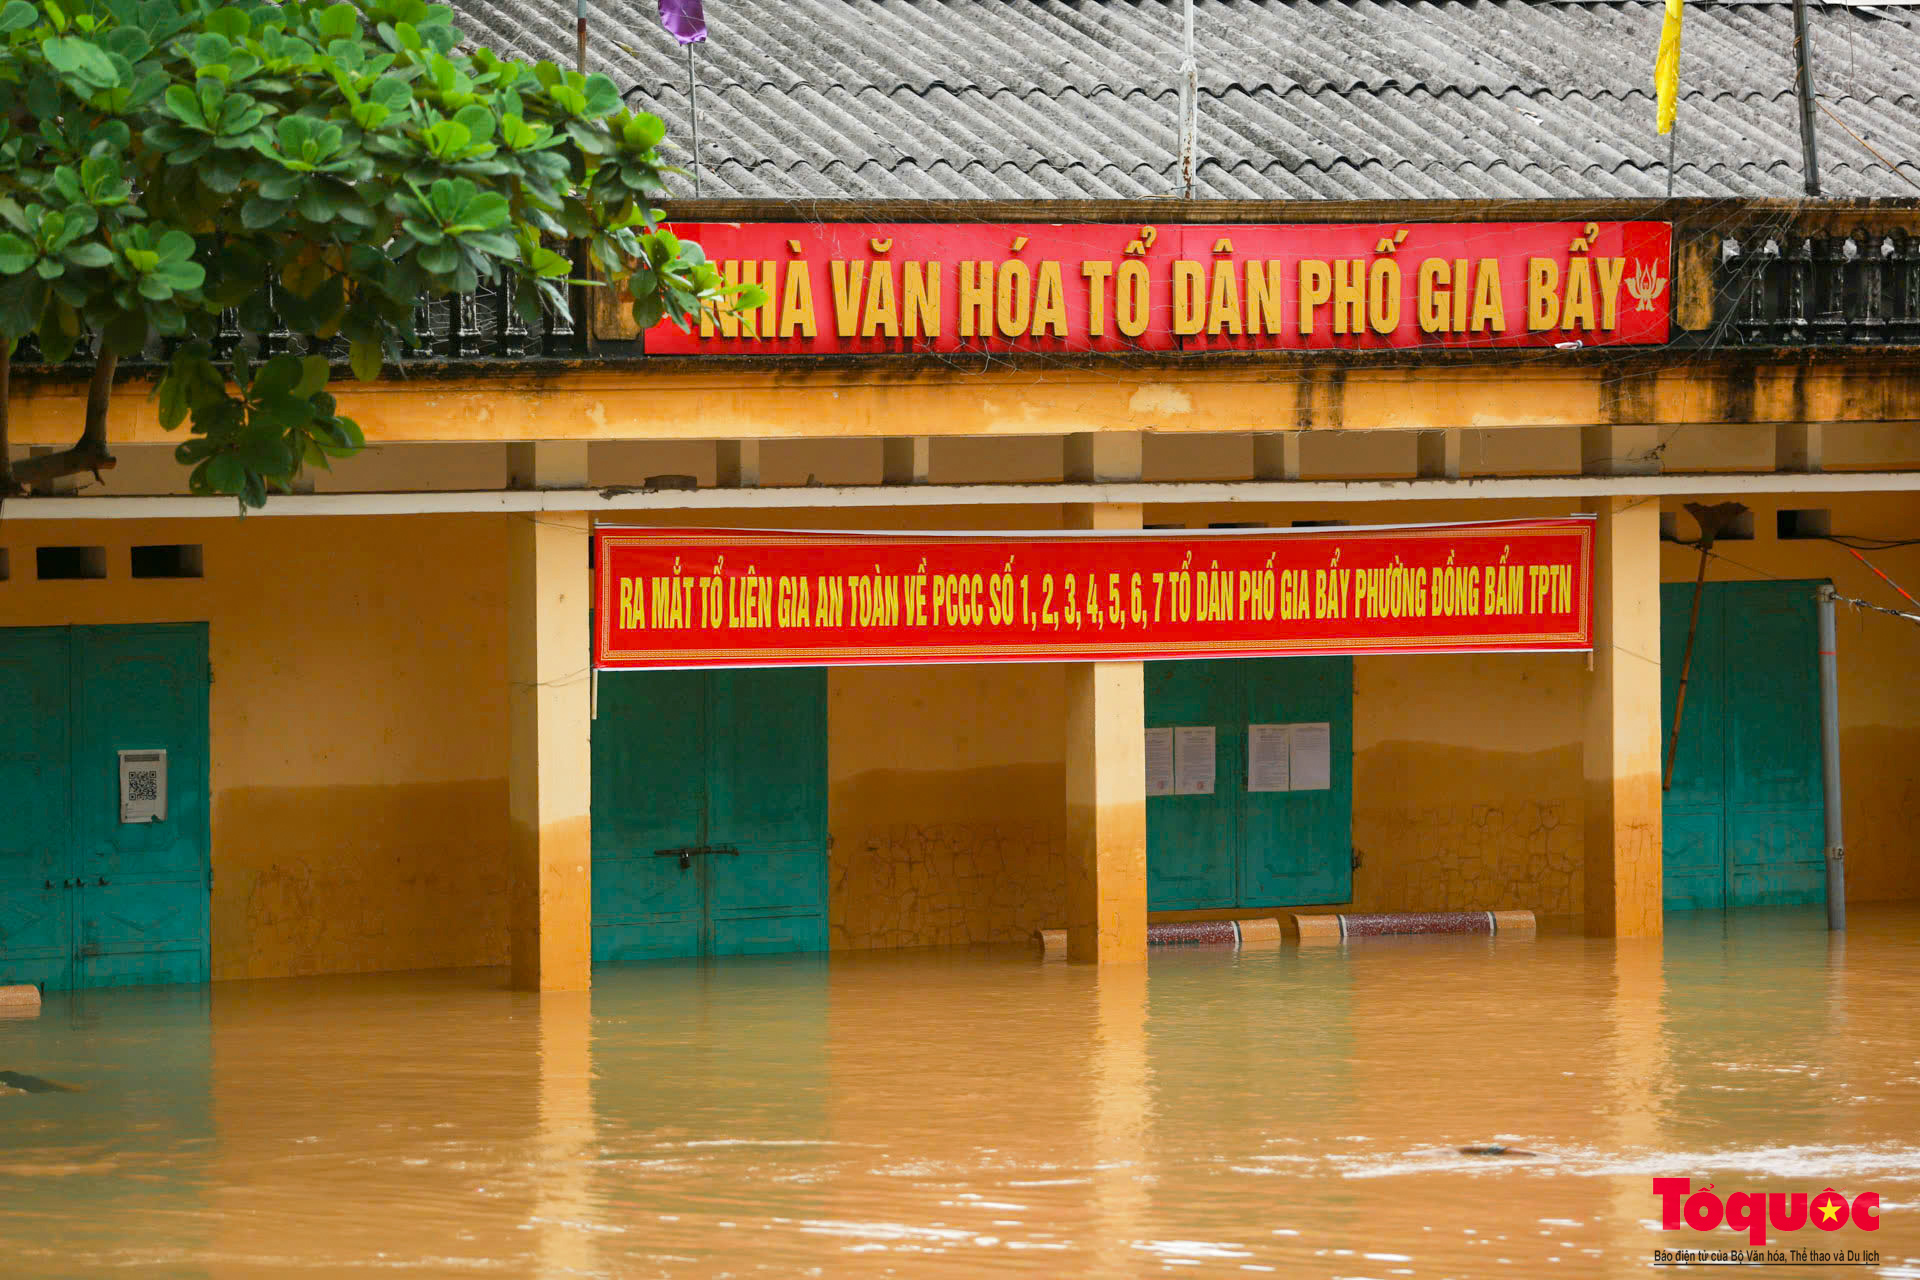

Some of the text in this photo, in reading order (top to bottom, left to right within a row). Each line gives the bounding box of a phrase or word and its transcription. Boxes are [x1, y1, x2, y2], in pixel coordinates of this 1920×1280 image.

[700, 222, 1626, 338] NHÀ VĂN HÓA TỔ DÂN PHỐ GIA BẨY
[619, 544, 1572, 632] RA MẮT TỔ LIÊN GIA AN TOÀN VỀ PCCC SỐ 1, 2, 3, 4, 5, 6, 7 TỔ DÂN PHỐ GIA BẨY PHƯỜNG ĐỒNG BẨM TPTN
